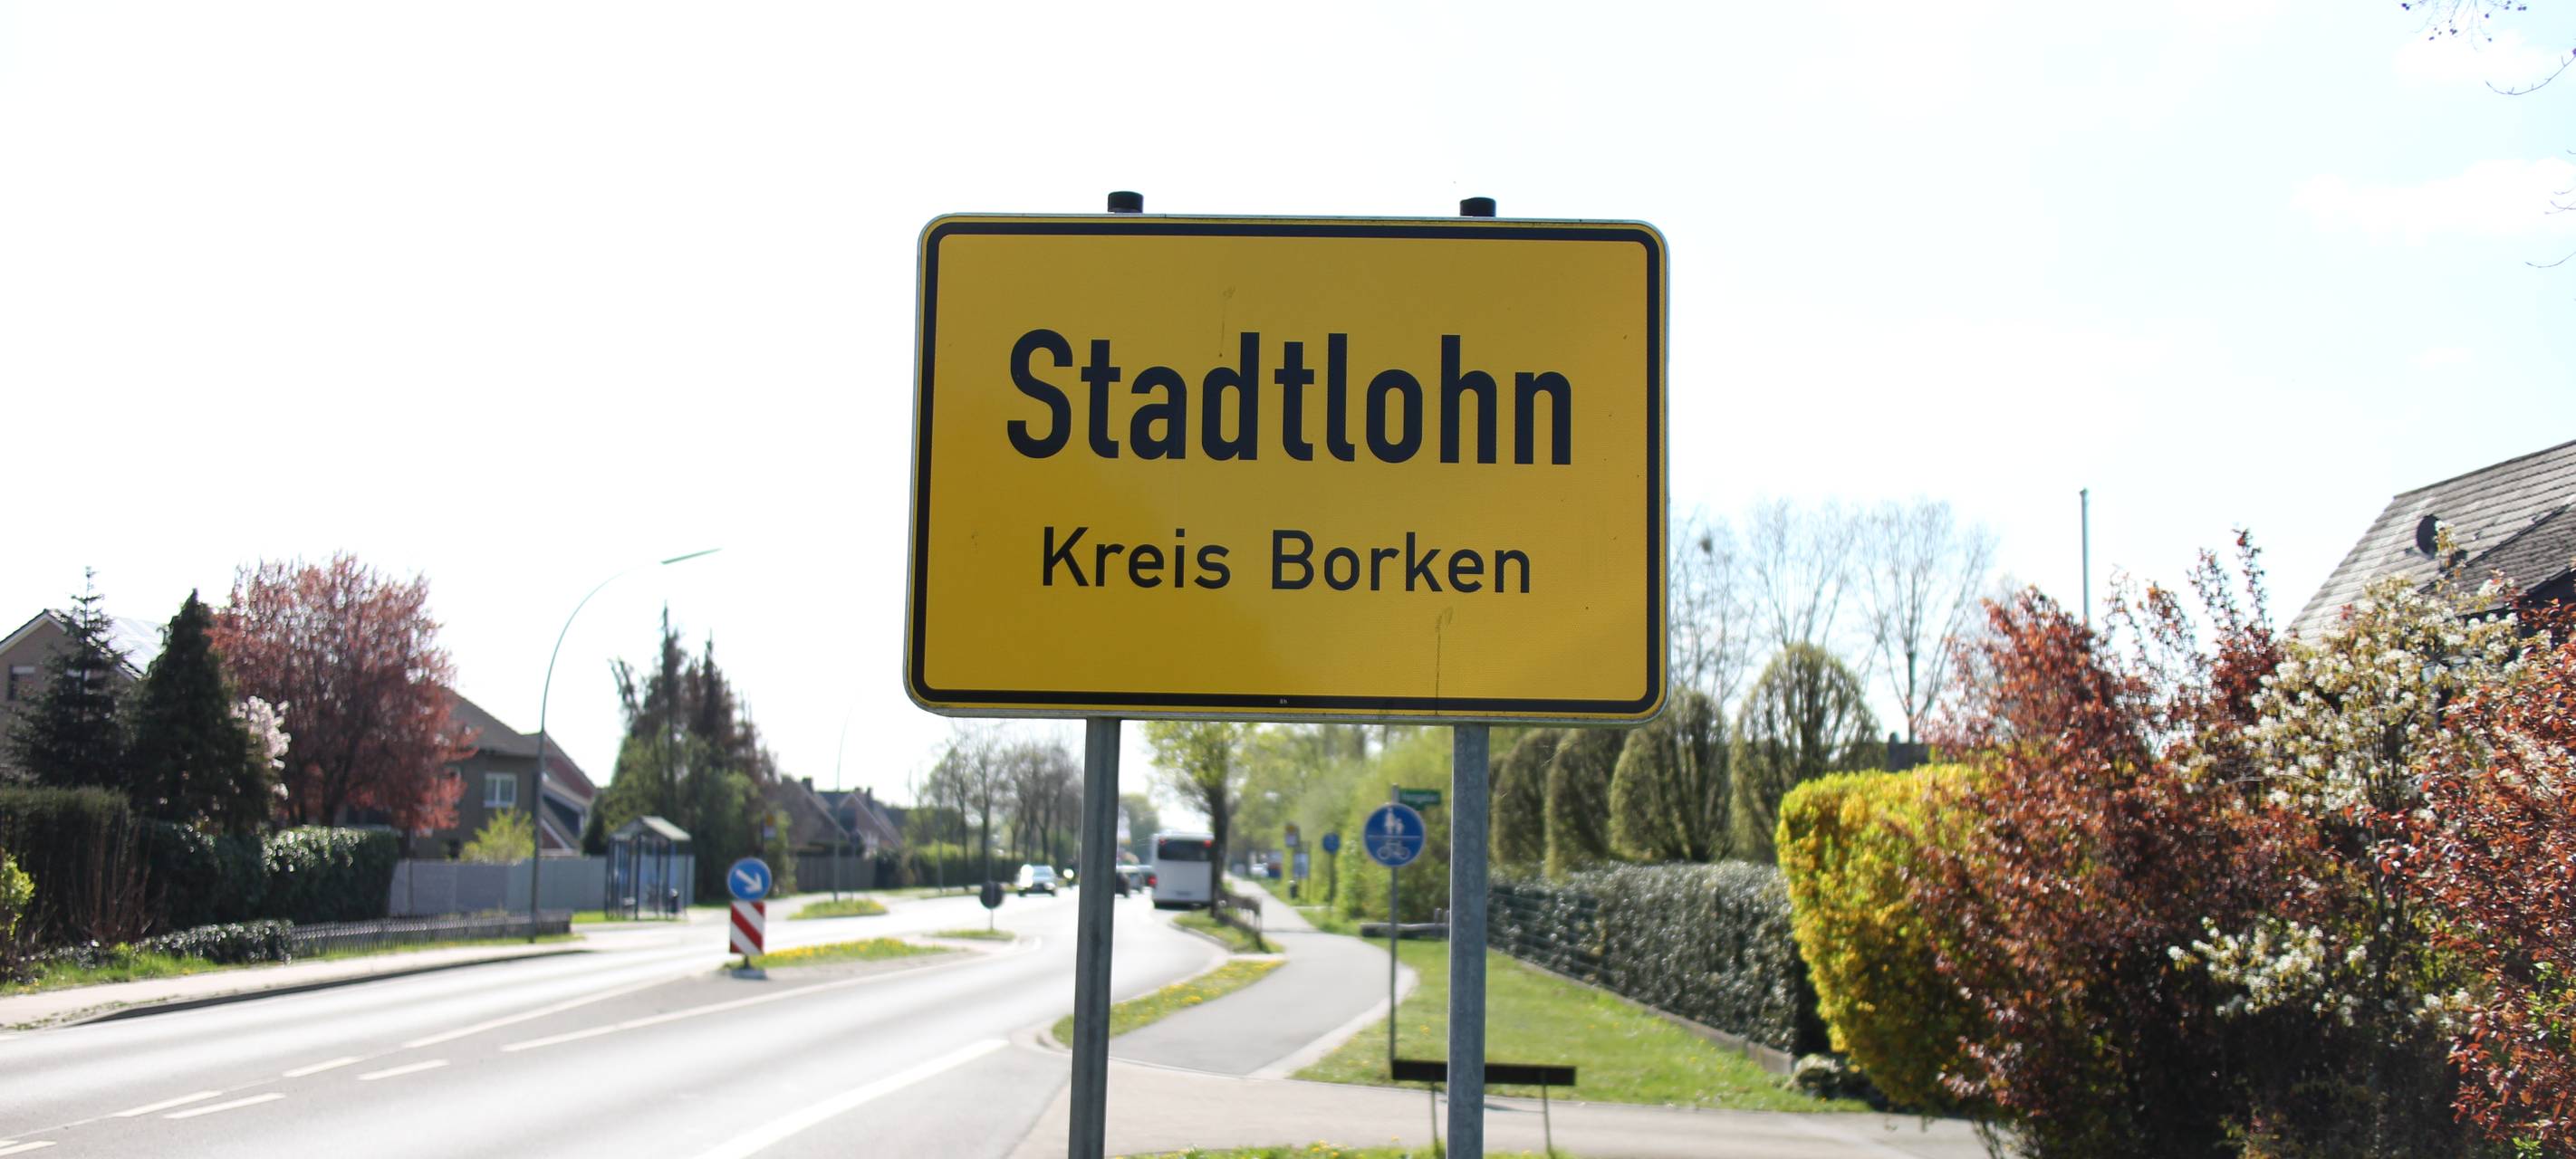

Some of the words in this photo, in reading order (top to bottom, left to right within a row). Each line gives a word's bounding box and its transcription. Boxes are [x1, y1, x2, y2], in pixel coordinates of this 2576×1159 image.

[1007, 329, 1572, 465] Stadtlohn
[1043, 526, 1231, 589] Kreis
[1272, 529, 1530, 594] Borken
